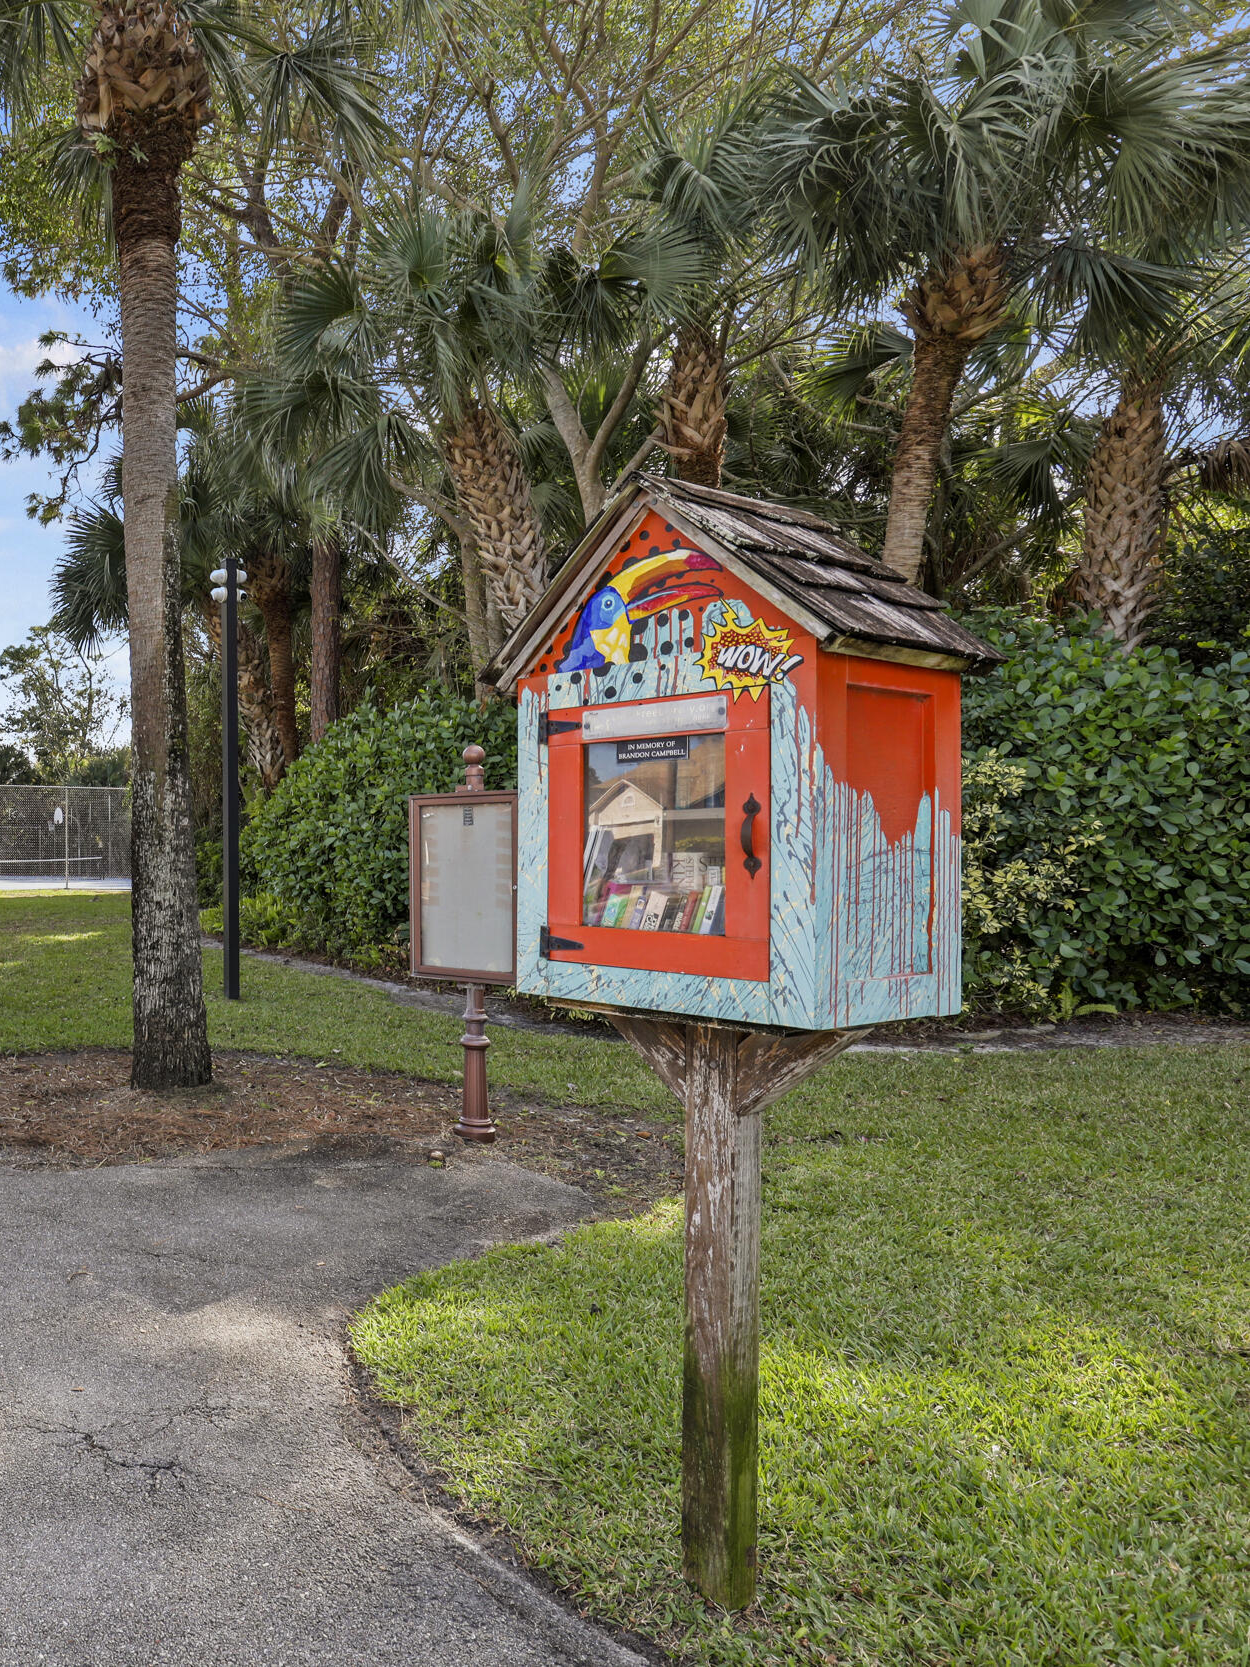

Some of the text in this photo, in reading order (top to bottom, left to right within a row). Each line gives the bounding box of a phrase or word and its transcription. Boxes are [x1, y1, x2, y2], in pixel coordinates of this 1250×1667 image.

[716, 644, 804, 681] WOW!
[636, 740, 665, 750] MEMORY
[666, 740, 676, 748] OF
[618, 748, 686, 760] BRANDON CAMPBELL
